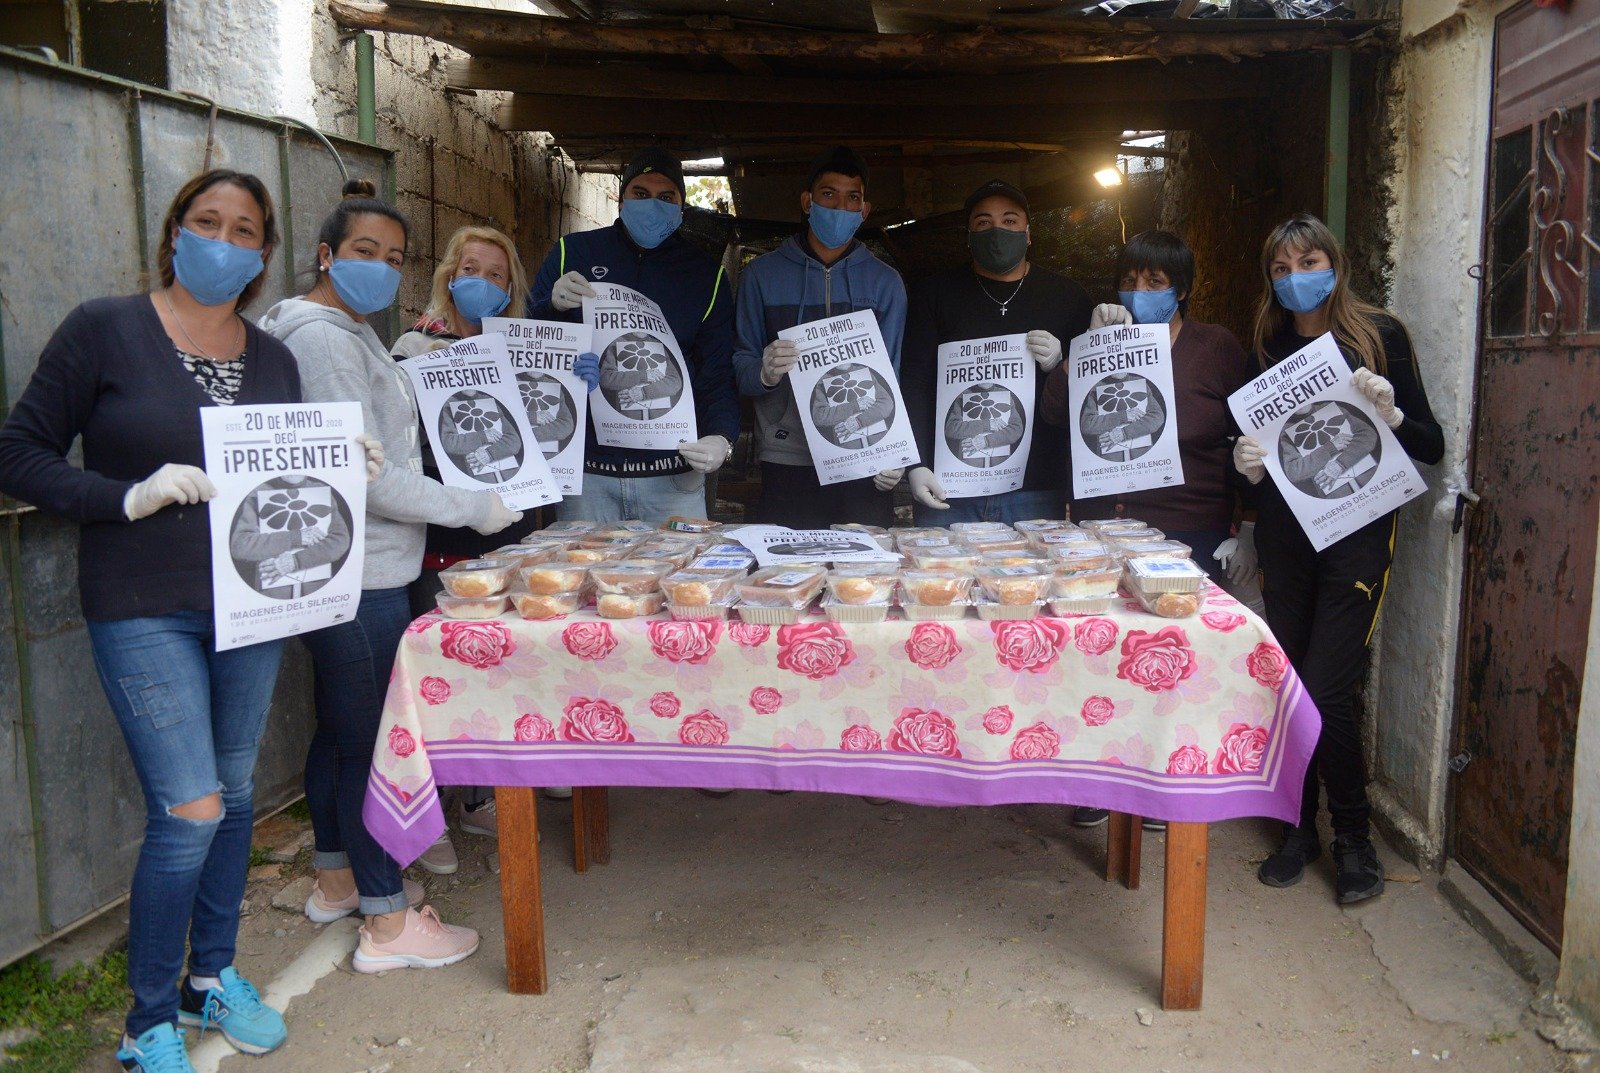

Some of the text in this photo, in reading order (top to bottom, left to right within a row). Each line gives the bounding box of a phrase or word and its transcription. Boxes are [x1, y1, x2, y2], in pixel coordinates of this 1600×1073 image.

[610, 289, 621, 300] 20
[622, 293, 631, 303] DE
[509, 324, 521, 337] 20
[524, 328, 533, 339] DE
[536, 326, 563, 341] MAYO
[595, 313, 668, 335] ¡PRESENTE!
[806, 327, 818, 341] 20
[820, 327, 830, 337] DE
[830, 319, 854, 334] MAYO
[526, 341, 542, 350] DECÍ
[826, 335, 841, 346] DECÍ
[1090, 334, 1100, 348] 20
[1103, 334, 1112, 345] DE
[1114, 328, 1140, 342] MAYO
[451, 343, 479, 357] MAYO
[797, 338, 876, 372] ¡PRESENTE!
[960, 345, 971, 357] 20
[974, 346, 982, 356] DE
[984, 341, 1008, 354] MAYO
[1106, 343, 1122, 354] DECÍ
[450, 357, 466, 368] DECÍ
[976, 355, 990, 365] DECÍ
[1078, 348, 1159, 379] ¡PRESENTE!
[421, 367, 502, 390] ¡PRESENTE!
[946, 363, 1024, 385] ¡PRESENTE!
[1244, 392, 1256, 402] ESTE
[1254, 379, 1268, 394] 20
[1269, 373, 1280, 385] DE
[1279, 354, 1308, 379] MAYO
[1277, 376, 1294, 393] DECÍ
[1248, 366, 1339, 430] ¡PRESENTE!
[225, 411, 343, 432] ESTE 20 DE MAYO 2020
[274, 431, 297, 445] DECÍ
[224, 444, 349, 474] ¡PRESENTE!
[823, 440, 908, 466] IMAGENES DEL SILENCIO
[994, 467, 1021, 475] SILENCIO
[1082, 459, 1172, 477] IMAGENES DEL SILENCIO
[497, 486, 510, 494] DEL
[511, 479, 544, 491] SILENCIO
[1312, 471, 1406, 527] IMAGENES DEL SILENCIO
[230, 594, 350, 621] IMAGENES DEL SILENCIO
